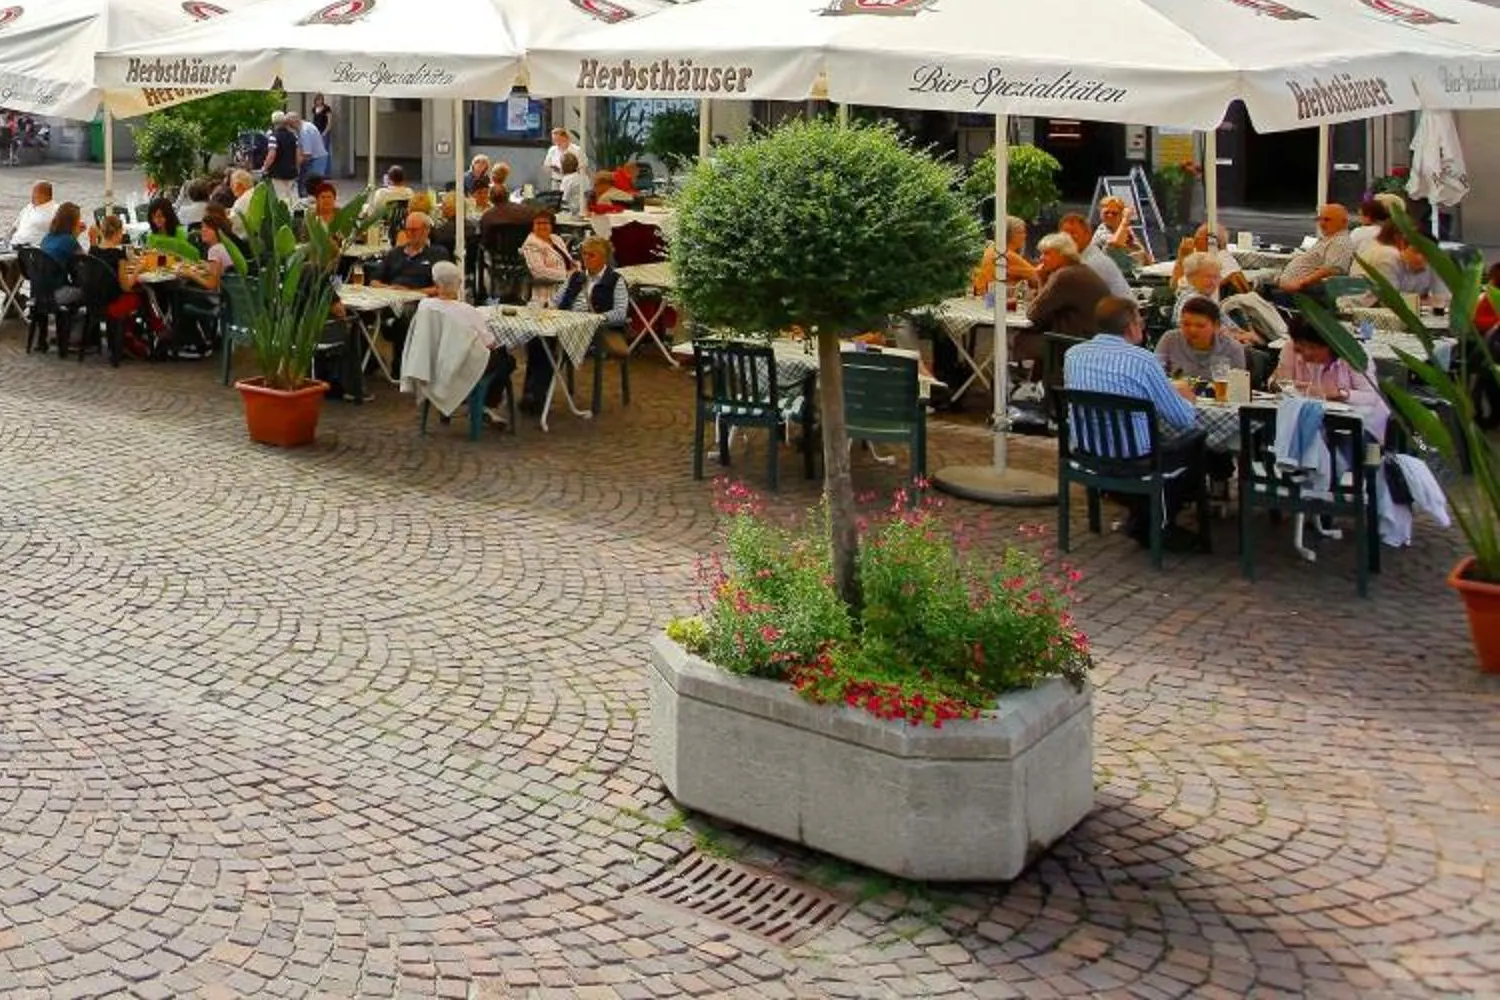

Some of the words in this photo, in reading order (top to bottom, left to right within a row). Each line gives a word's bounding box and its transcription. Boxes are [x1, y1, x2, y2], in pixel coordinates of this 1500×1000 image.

[126, 58, 237, 84] Herbsthäuser
[576, 58, 753, 93] Herbsthäuser
[908, 65, 1128, 109] Bier-Spezialitäten
[1286, 73, 1394, 120] Herbsthäuser
